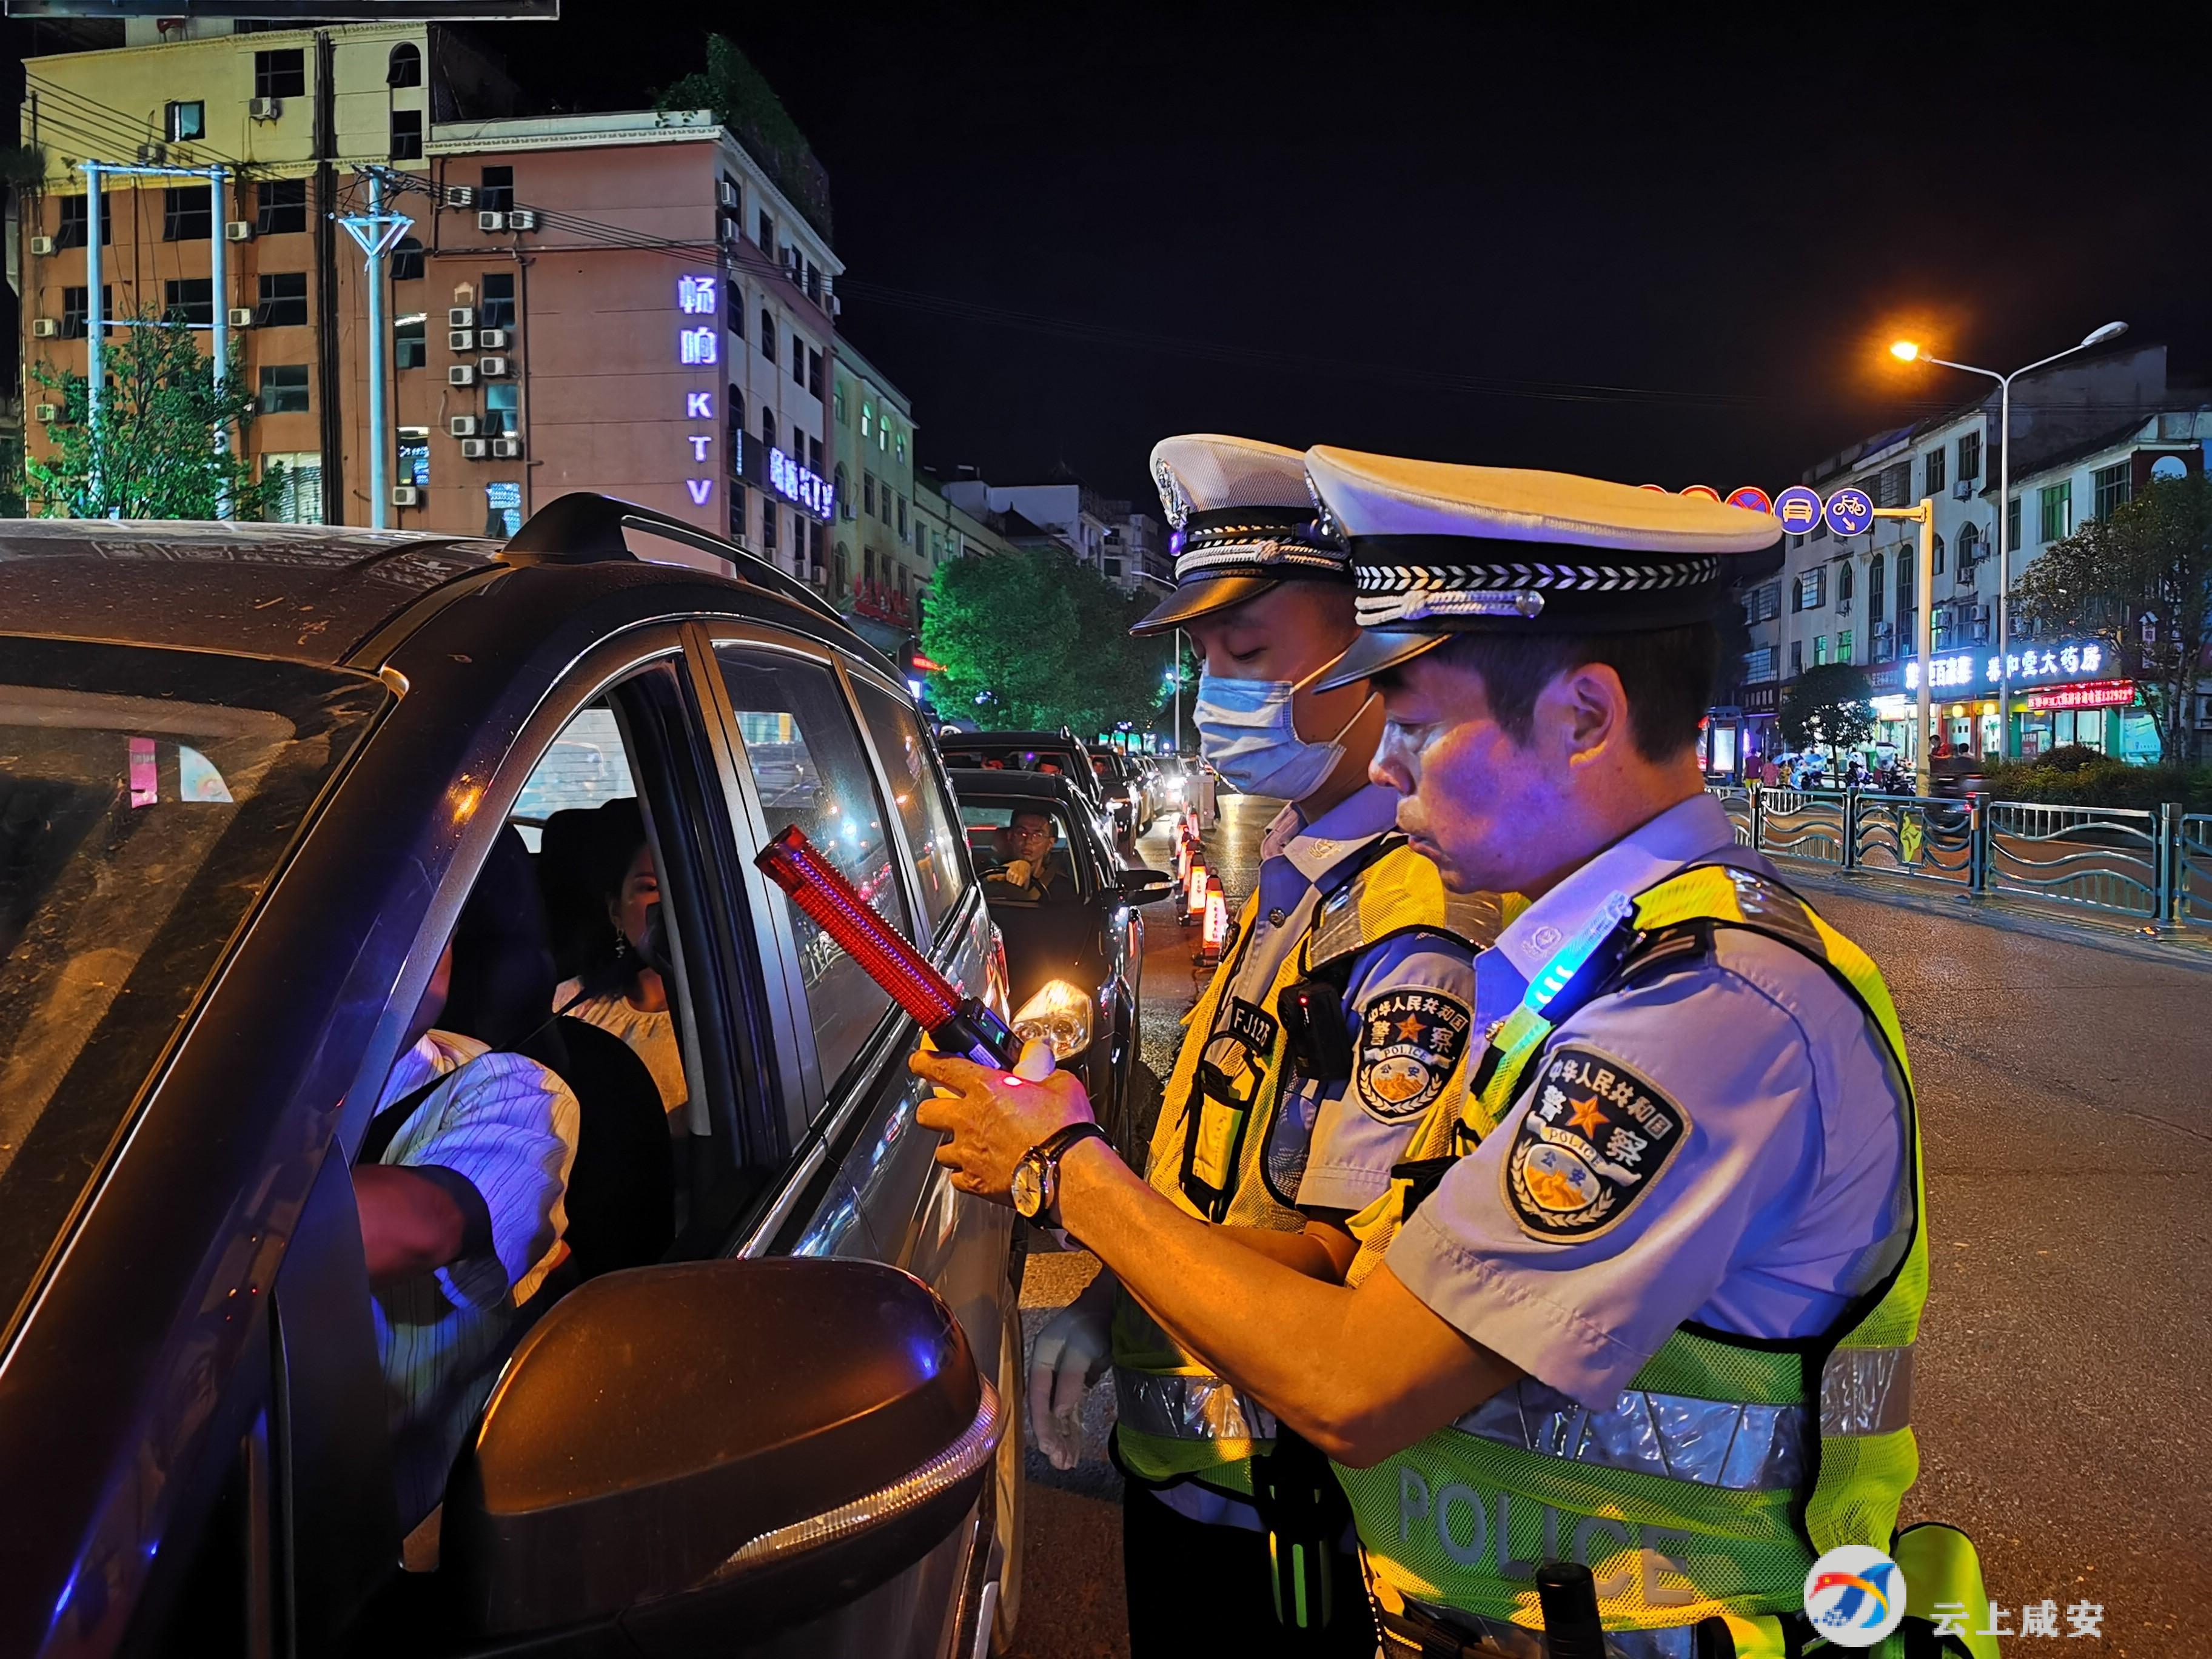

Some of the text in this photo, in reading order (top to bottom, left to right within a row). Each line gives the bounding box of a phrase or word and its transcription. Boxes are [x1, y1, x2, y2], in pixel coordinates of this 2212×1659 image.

[1368, 995, 1469, 1033] 中华人民共和国
[1383, 1045, 1429, 1061] POLICE
[1548, 1058, 1674, 1141] 中华人民共和国
[1549, 1128, 1606, 1168] POLICE
[1398, 1465, 1695, 1606] POLICE
